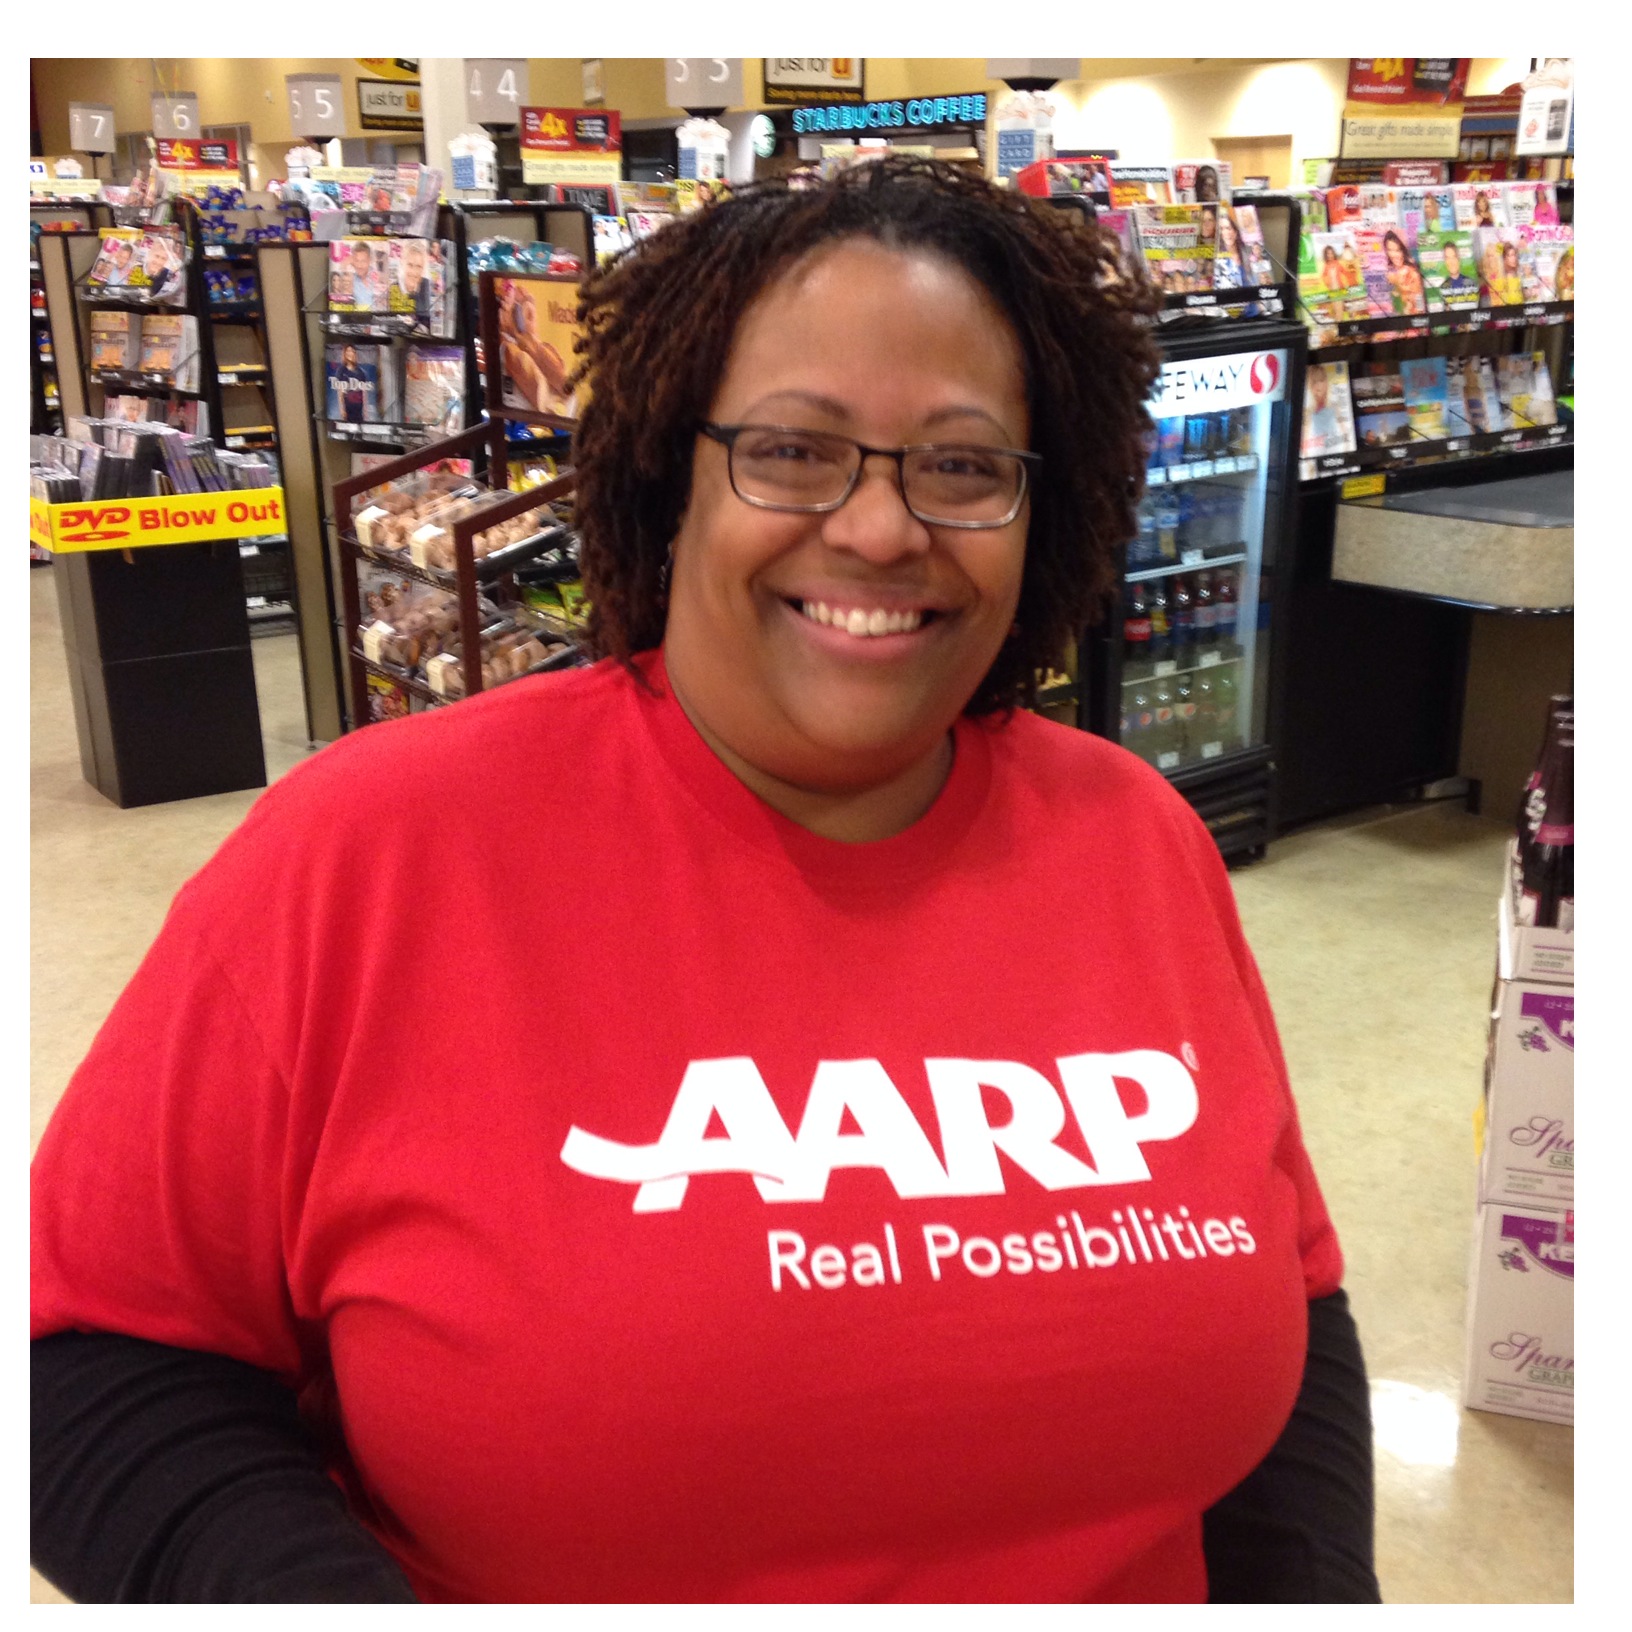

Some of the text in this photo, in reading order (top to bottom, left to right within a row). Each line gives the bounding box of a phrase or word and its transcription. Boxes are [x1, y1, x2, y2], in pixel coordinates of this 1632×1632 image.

[497, 69, 519, 102] 4
[173, 104, 191, 130] 6
[316, 88, 334, 119] 5
[792, 94, 987, 133] STARBUCKS COFFEE
[90, 115, 105, 138] 7
[59, 500, 280, 530] DVD Blow Out
[560, 1048, 1199, 1214] AARP
[767, 1205, 1257, 1291] Real Possibilities
